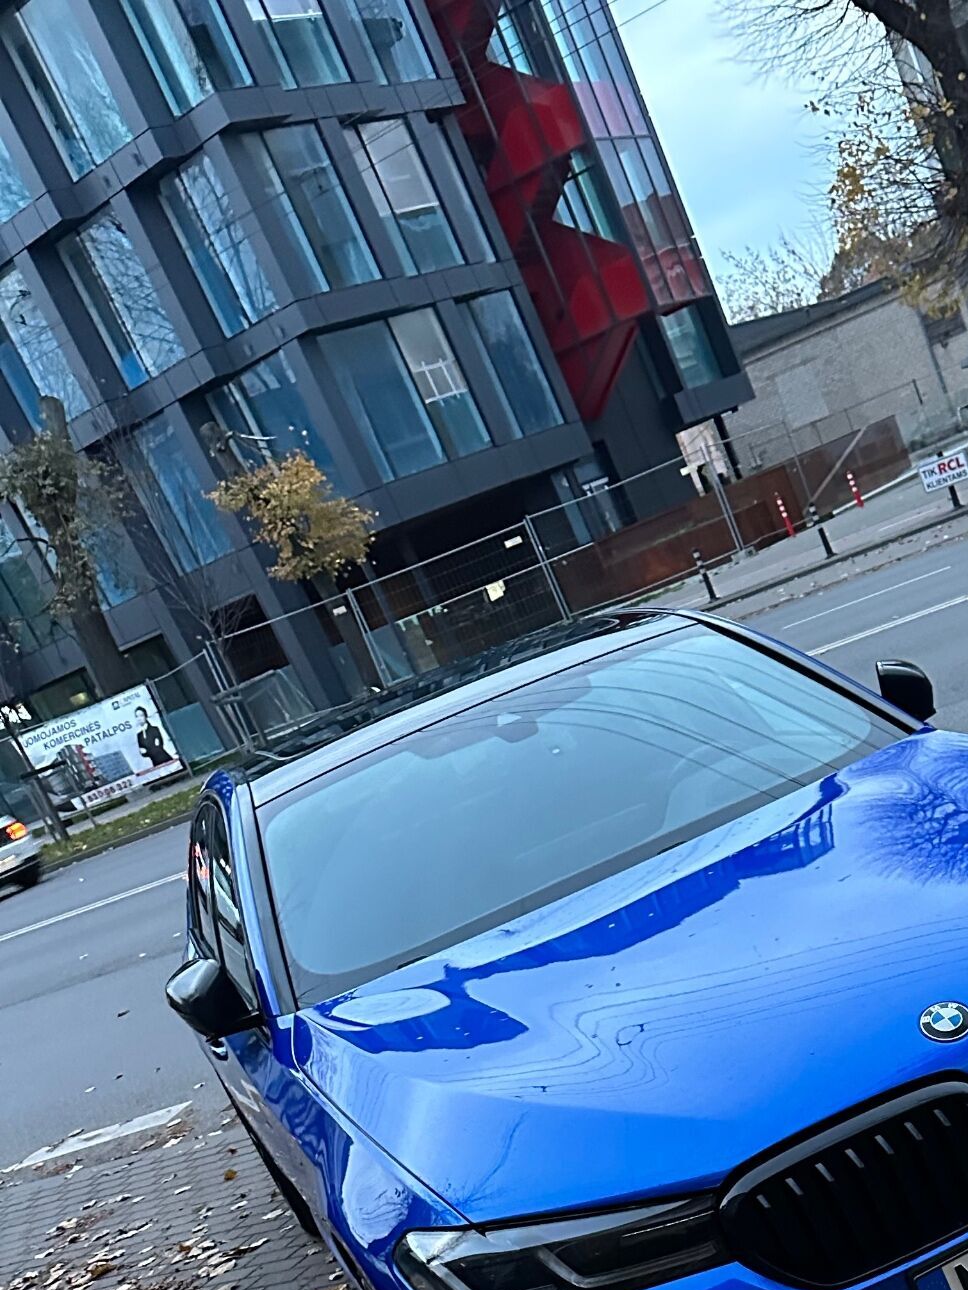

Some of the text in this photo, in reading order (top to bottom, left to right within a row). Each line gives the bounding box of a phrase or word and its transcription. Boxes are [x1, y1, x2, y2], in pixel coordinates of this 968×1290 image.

[922, 457, 965, 479] TIK RCL
[926, 469, 968, 490] KLIENTAMS
[84, 720, 133, 747] PATALPOS
